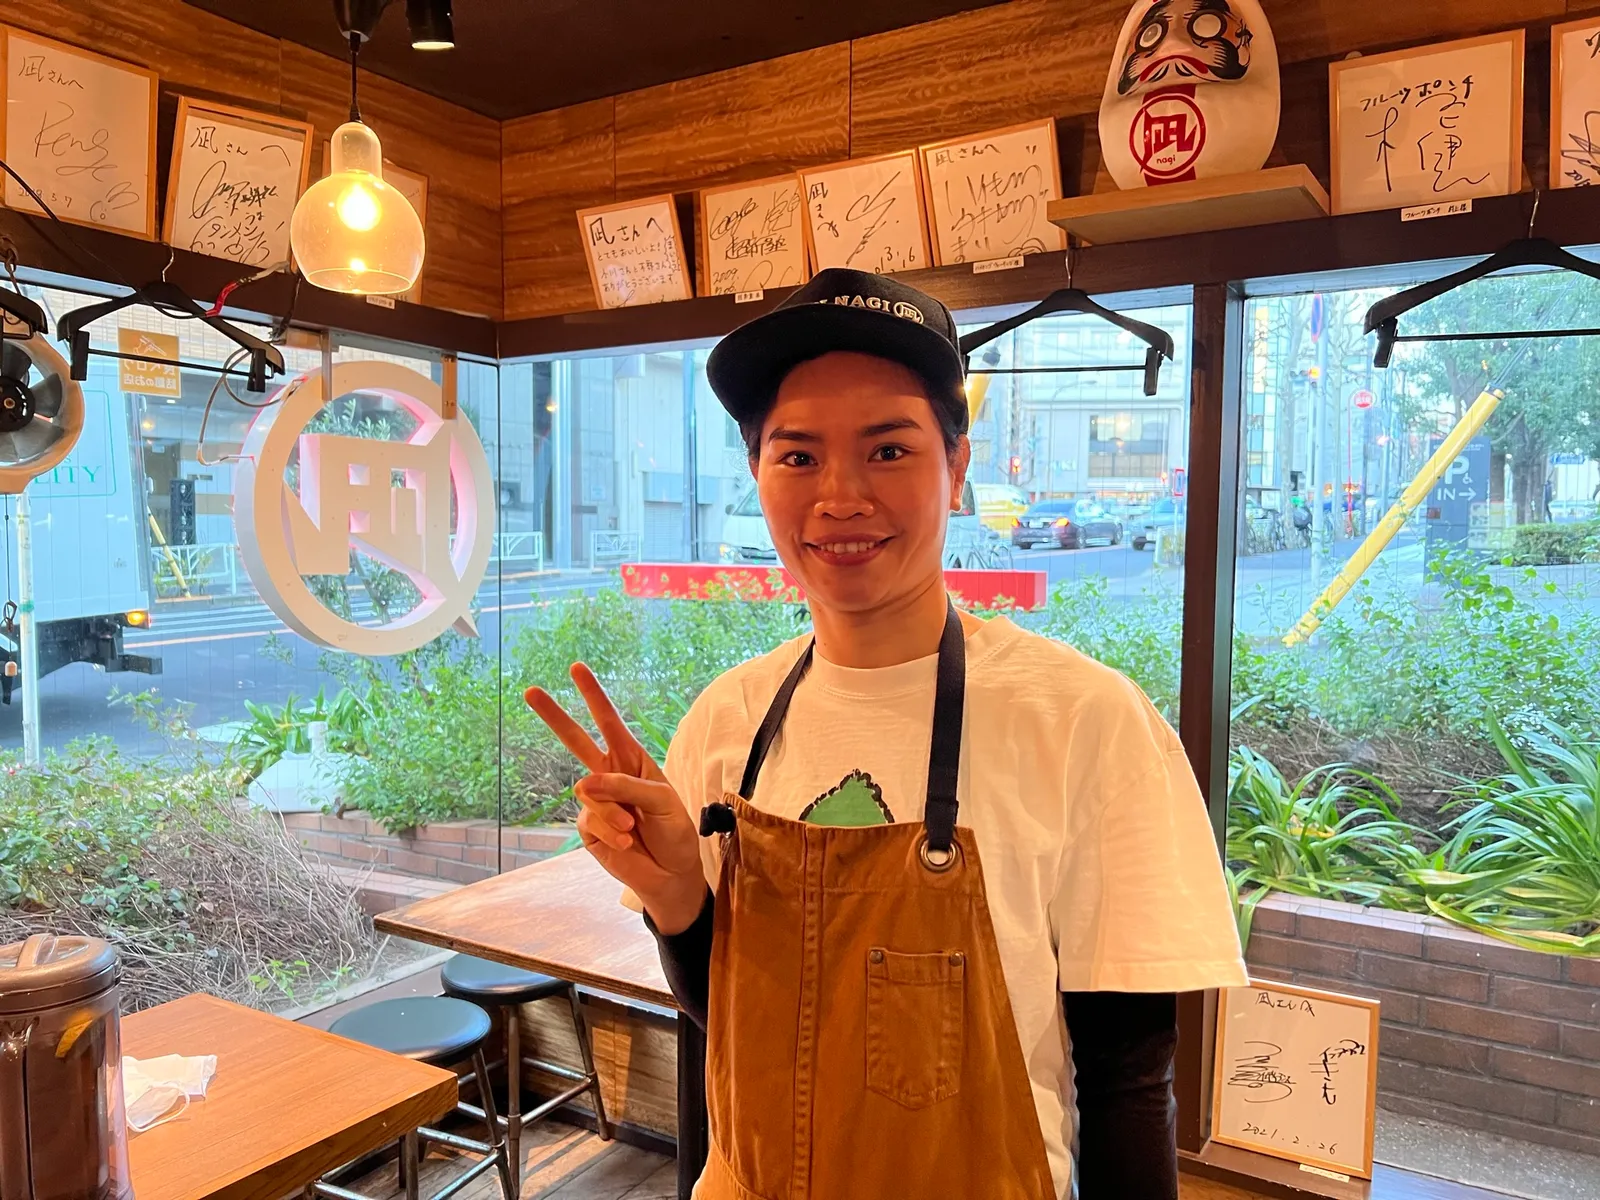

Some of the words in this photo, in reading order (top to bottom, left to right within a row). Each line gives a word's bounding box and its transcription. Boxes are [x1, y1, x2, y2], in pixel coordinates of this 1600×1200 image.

[1360, 75, 1474, 112] フルーツポンチ
[1156, 154, 1176, 165] nagi
[590, 216, 665, 247] 凪さんへ
[834, 294, 891, 313] NAGI
[1444, 455, 1470, 485] P
[1437, 488, 1456, 501] IN
